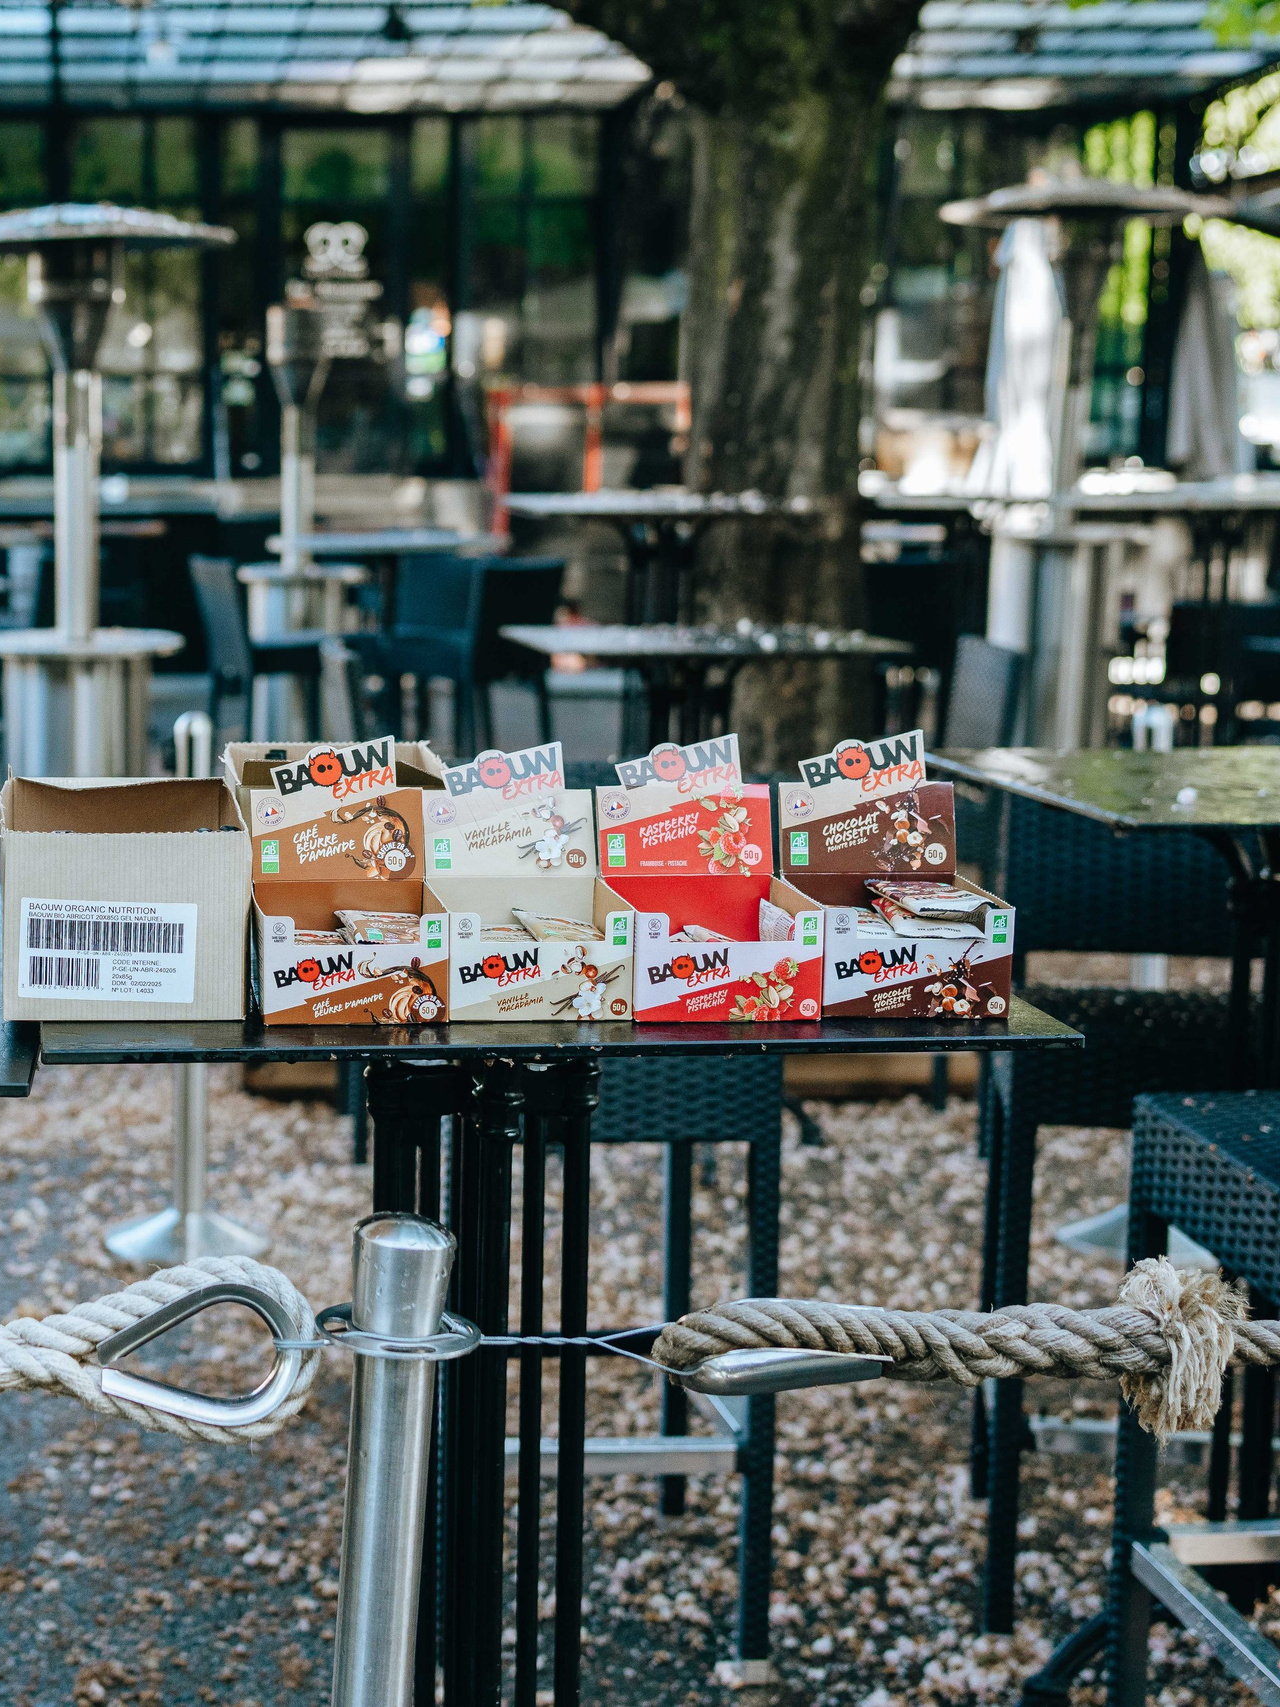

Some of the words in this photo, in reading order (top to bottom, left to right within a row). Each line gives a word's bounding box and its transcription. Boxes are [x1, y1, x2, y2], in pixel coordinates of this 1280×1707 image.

[275, 741, 389, 796] BAOUW
[445, 746, 556, 797] BAOUW
[619, 738, 731, 791] BAOUW
[802, 735, 916, 788] BAOUW
[332, 766, 394, 799] EXTRA
[502, 770, 563, 800] EXTRA
[677, 763, 739, 793] EXTRA
[861, 760, 924, 792] EXTRA
[293, 824, 319, 844] CAFÉ
[464, 821, 511, 841] VANILLE
[639, 812, 700, 838] RASPBERRY
[822, 811, 880, 837] CHOCOLAT
[825, 823, 880, 846] NOISETTE
[296, 833, 339, 855] BEURRE
[468, 826, 532, 851] MACADAMIA
[642, 825, 698, 849] PISTACHIO
[300, 839, 356, 864] D'AMANDE
[29, 903, 63, 911] BAOUW
[64, 904, 106, 913] ORGANIC
[108, 906, 156, 915] NUTRITION
[273, 950, 353, 989] BAOUW
[458, 947, 539, 985] BAOUW
[647, 947, 729, 985] BAOUW
[835, 943, 918, 981] BAOUW
[873, 961, 919, 983] EXTRA
[312, 968, 356, 991] EXTRA
[497, 964, 541, 988] EXTRA
[686, 965, 731, 988] EXTRA
[312, 998, 330, 1011] CAFÉ
[496, 992, 529, 1007] VANILLE
[498, 996, 544, 1013] MACADAMIA
[685, 989, 728, 1007] RASPBERRY
[687, 997, 726, 1014] PISTACHIO
[872, 985, 914, 1002] CHOCOLAT
[874, 994, 912, 1009] NOISETTE
[314, 1001, 343, 1019] BEURRE
